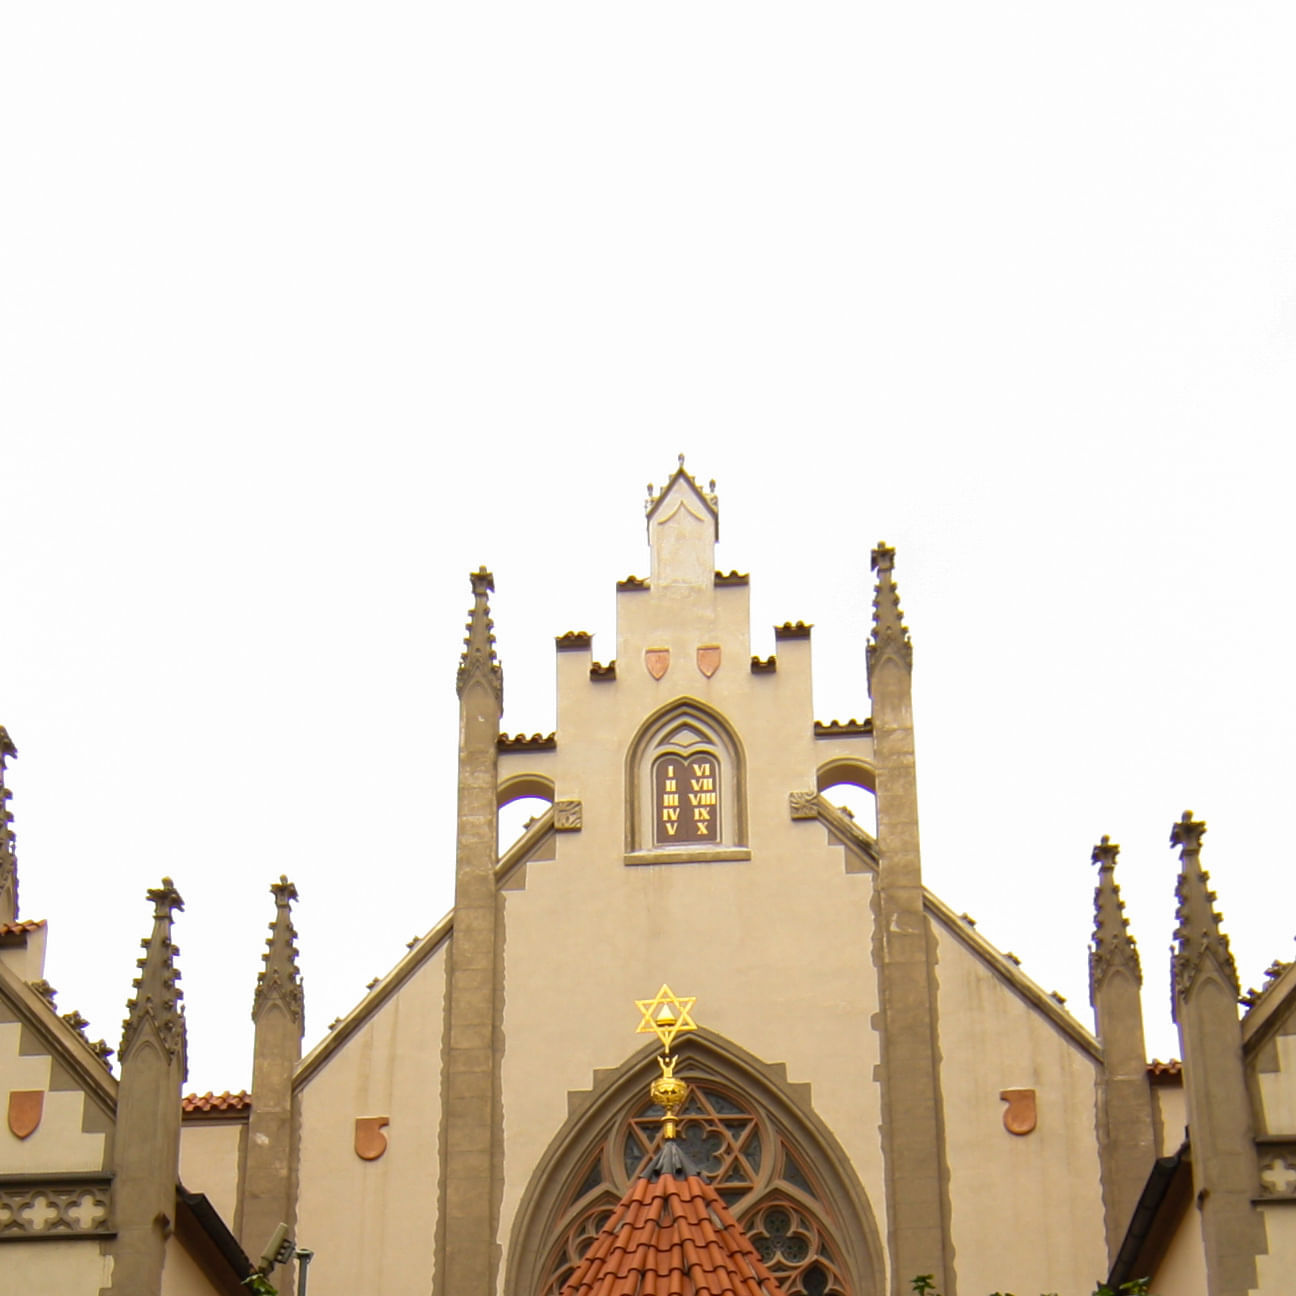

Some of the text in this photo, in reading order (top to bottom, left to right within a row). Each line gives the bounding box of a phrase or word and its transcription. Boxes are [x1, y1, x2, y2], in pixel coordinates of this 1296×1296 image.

[692, 763, 710, 777] VI
[665, 779, 676, 792] II
[690, 777, 713, 791] VII
[663, 793, 679, 807] III
[688, 792, 716, 806] VIII
[662, 807, 680, 821] IV
[693, 807, 711, 820] IX
[665, 822, 678, 835] V
[696, 822, 709, 834] X
